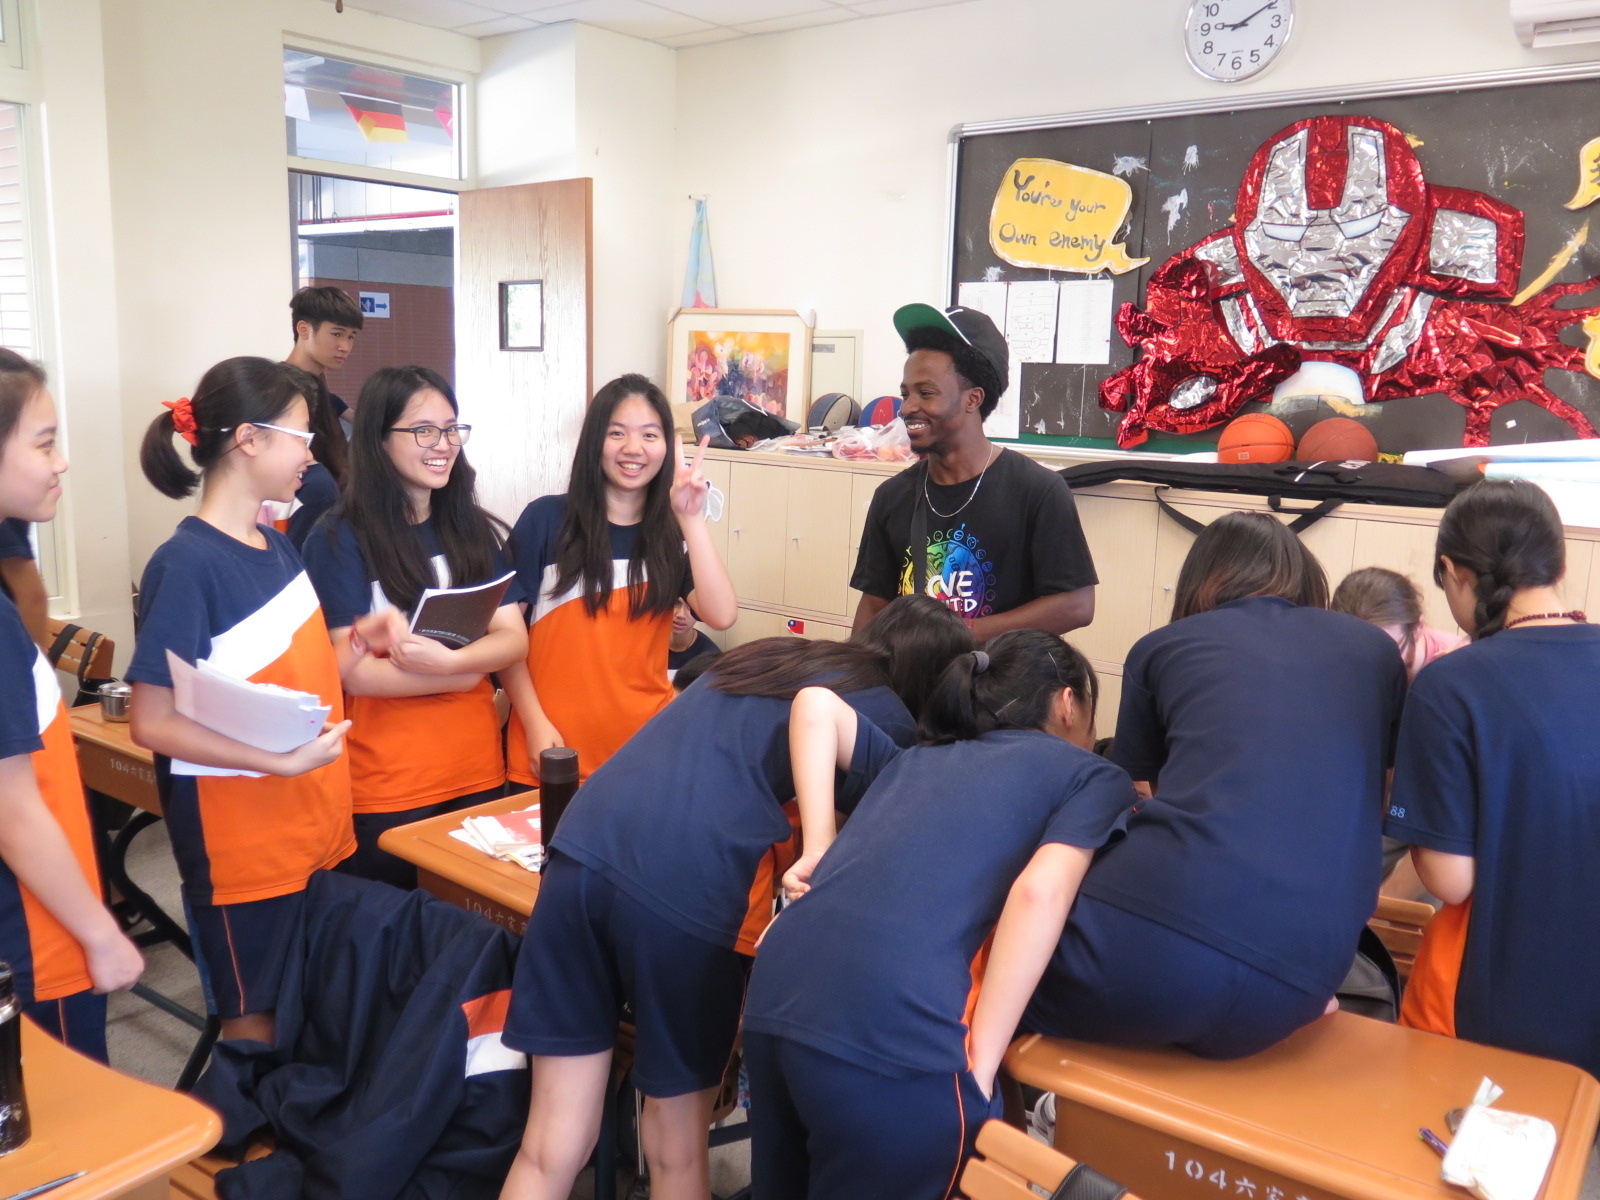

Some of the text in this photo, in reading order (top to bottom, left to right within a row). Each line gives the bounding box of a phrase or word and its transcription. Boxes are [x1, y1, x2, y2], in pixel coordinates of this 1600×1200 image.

[1203, 3, 1219, 17] 10
[1270, 14, 1281, 28] 3
[1200, 23, 1211, 36] 9
[1203, 41, 1213, 54] 8
[1264, 34, 1275, 48] 4
[1217, 53, 1227, 66] 7
[1250, 49, 1260, 63] 5
[1231, 57, 1242, 70] 6
[1013, 169, 1106, 222] You're your
[999, 222, 1106, 262] Own enemy
